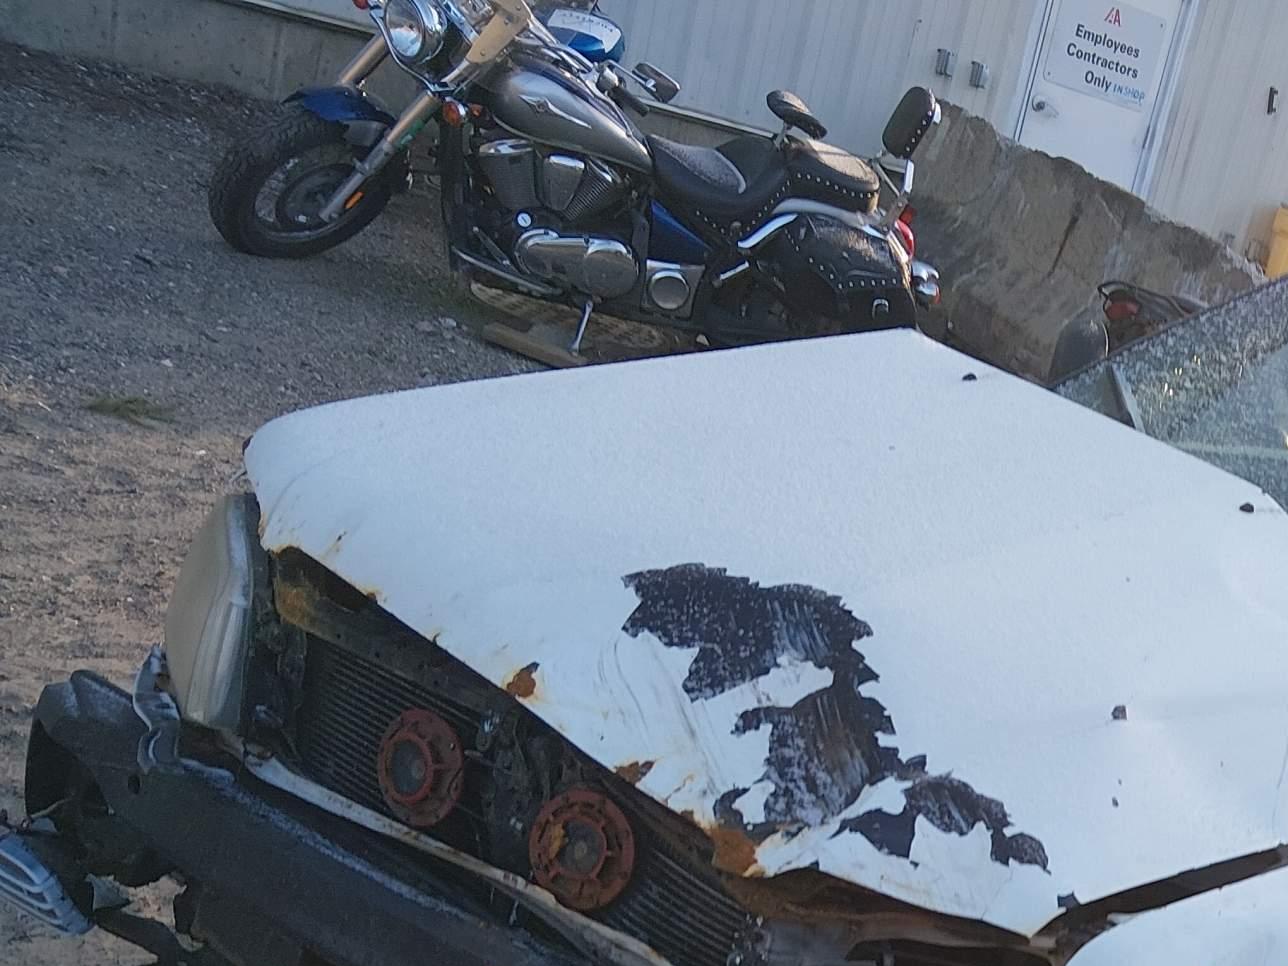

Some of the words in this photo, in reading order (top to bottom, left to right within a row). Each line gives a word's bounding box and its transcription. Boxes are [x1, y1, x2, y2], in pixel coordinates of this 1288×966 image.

[1075, 23, 1140, 58] Employees
[1066, 42, 1139, 79] Contractors
[1084, 70, 1112, 93] Only
